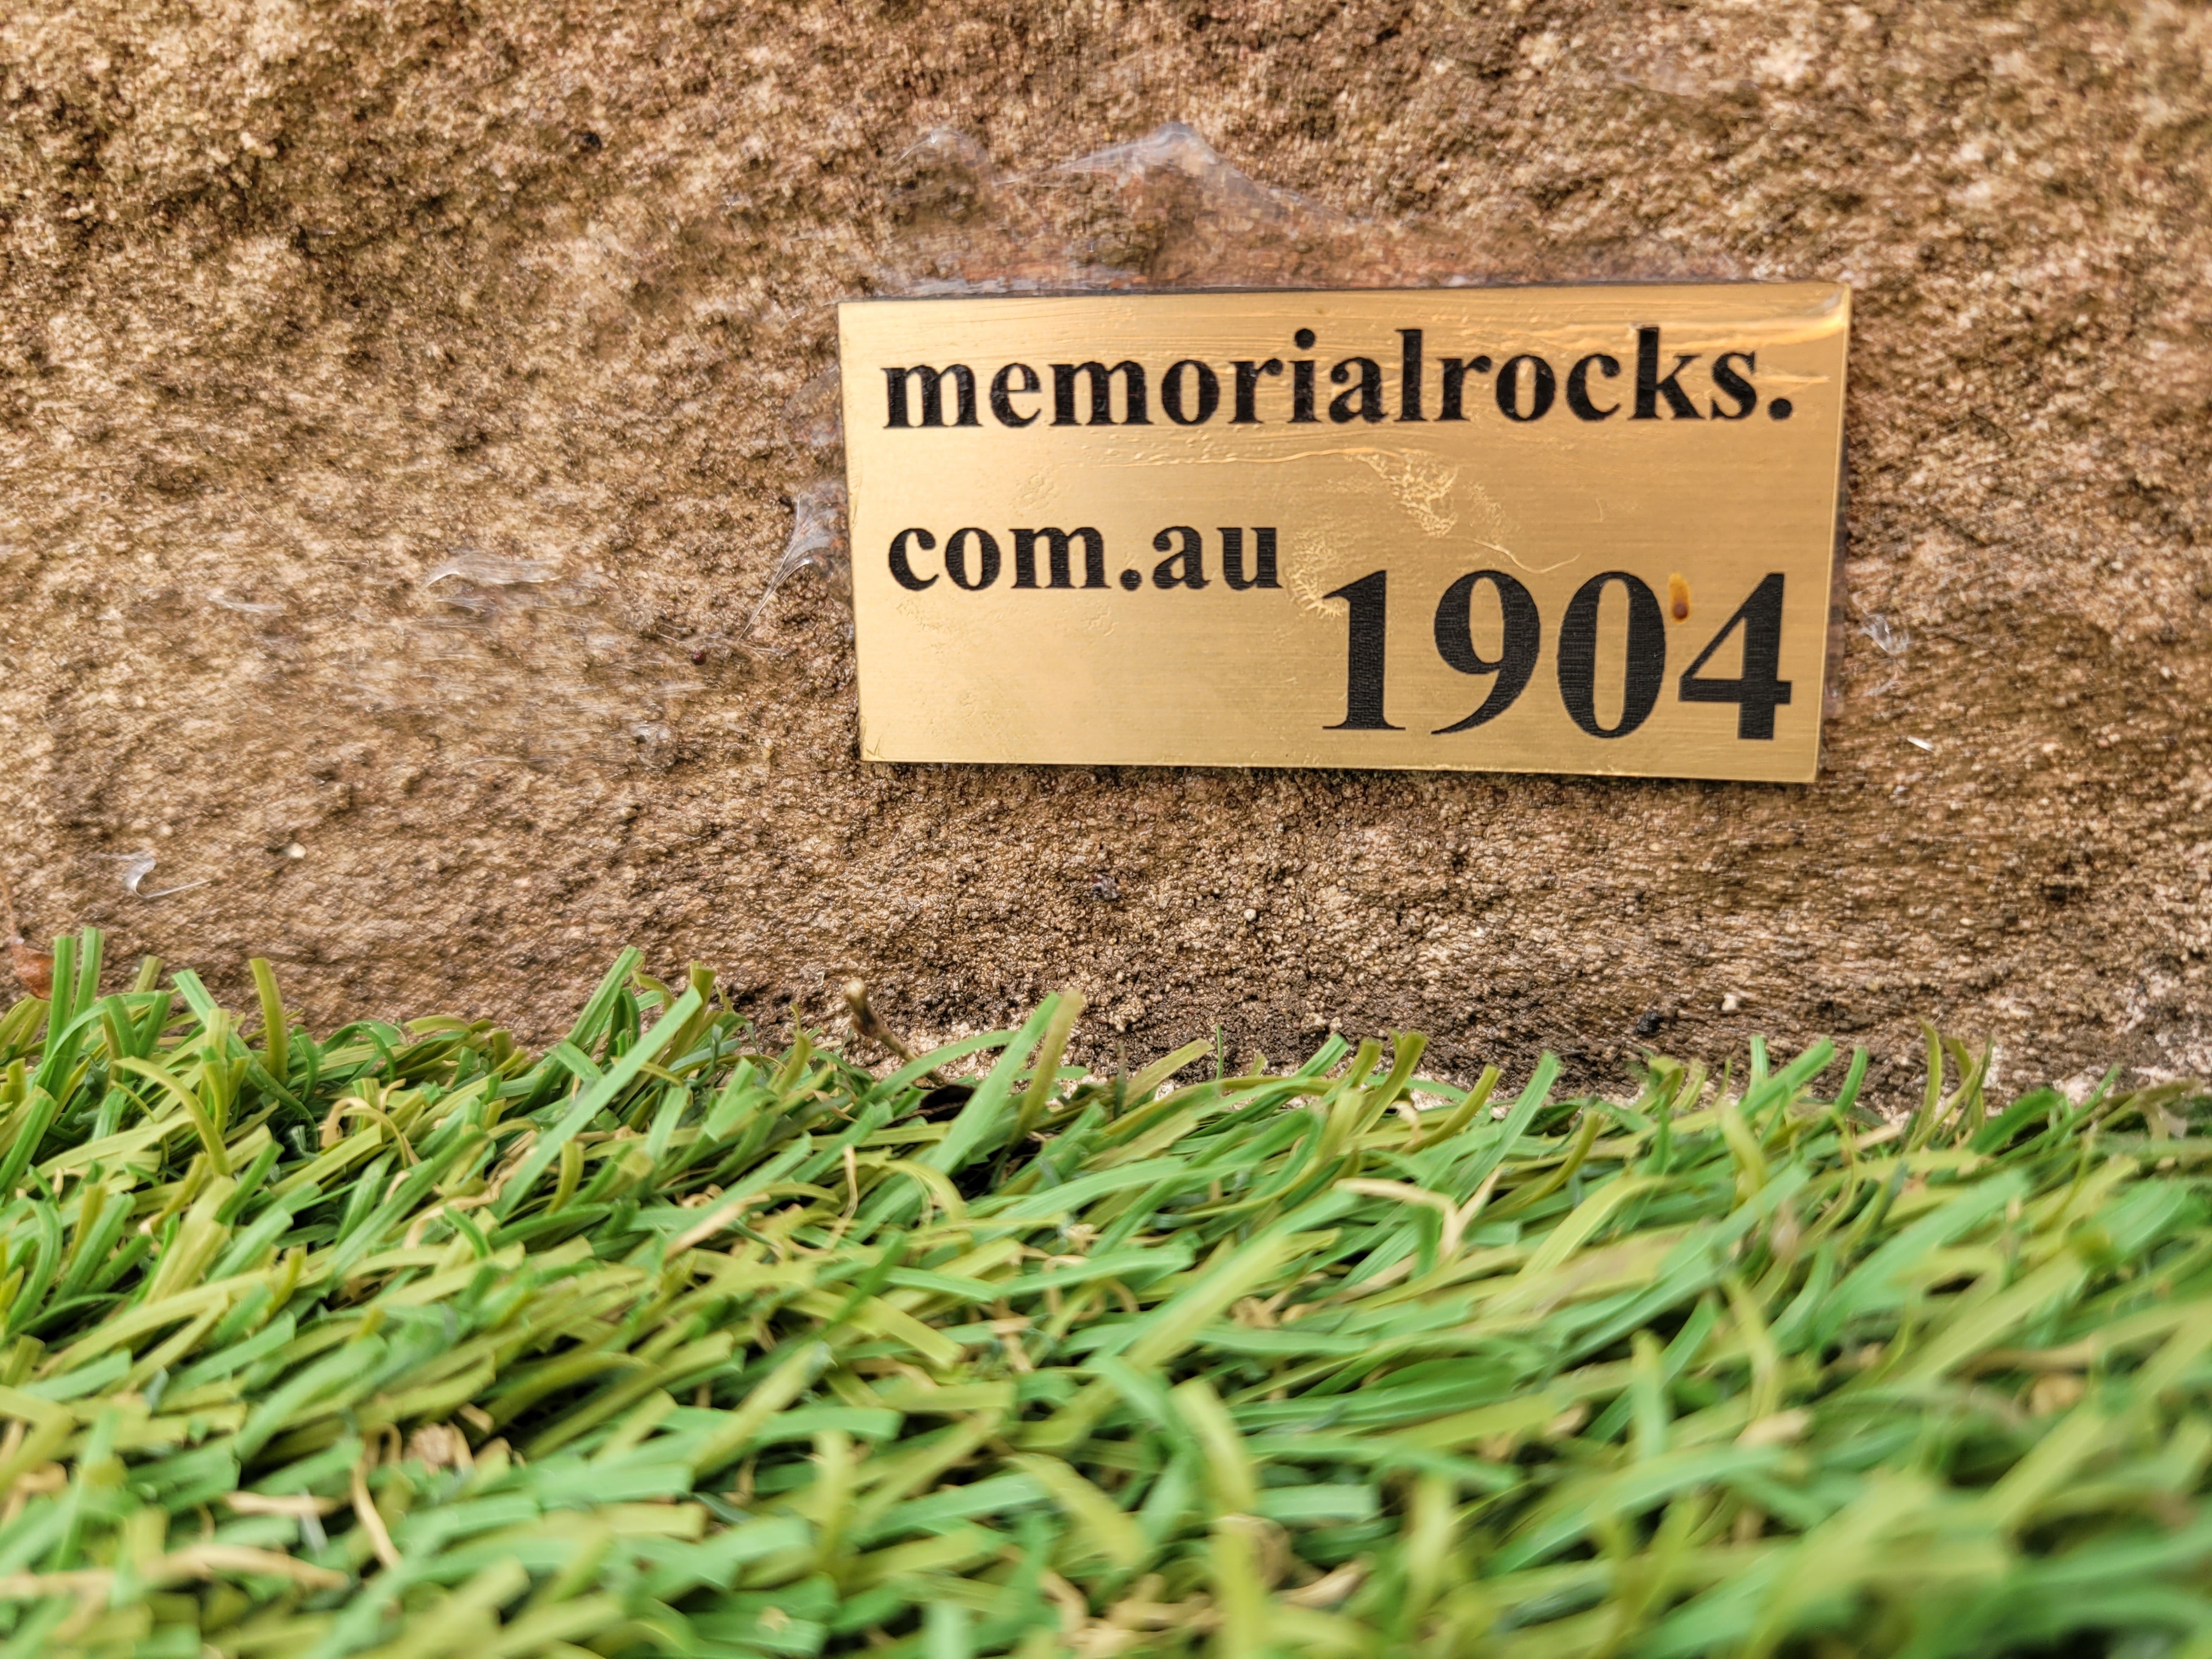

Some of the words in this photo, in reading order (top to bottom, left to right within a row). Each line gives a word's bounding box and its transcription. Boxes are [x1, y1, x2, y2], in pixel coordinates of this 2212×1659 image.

[882, 326, 1794, 429] memorialrocks.
[887, 524, 1284, 592] com.au
[1321, 568, 1793, 741] 1904
